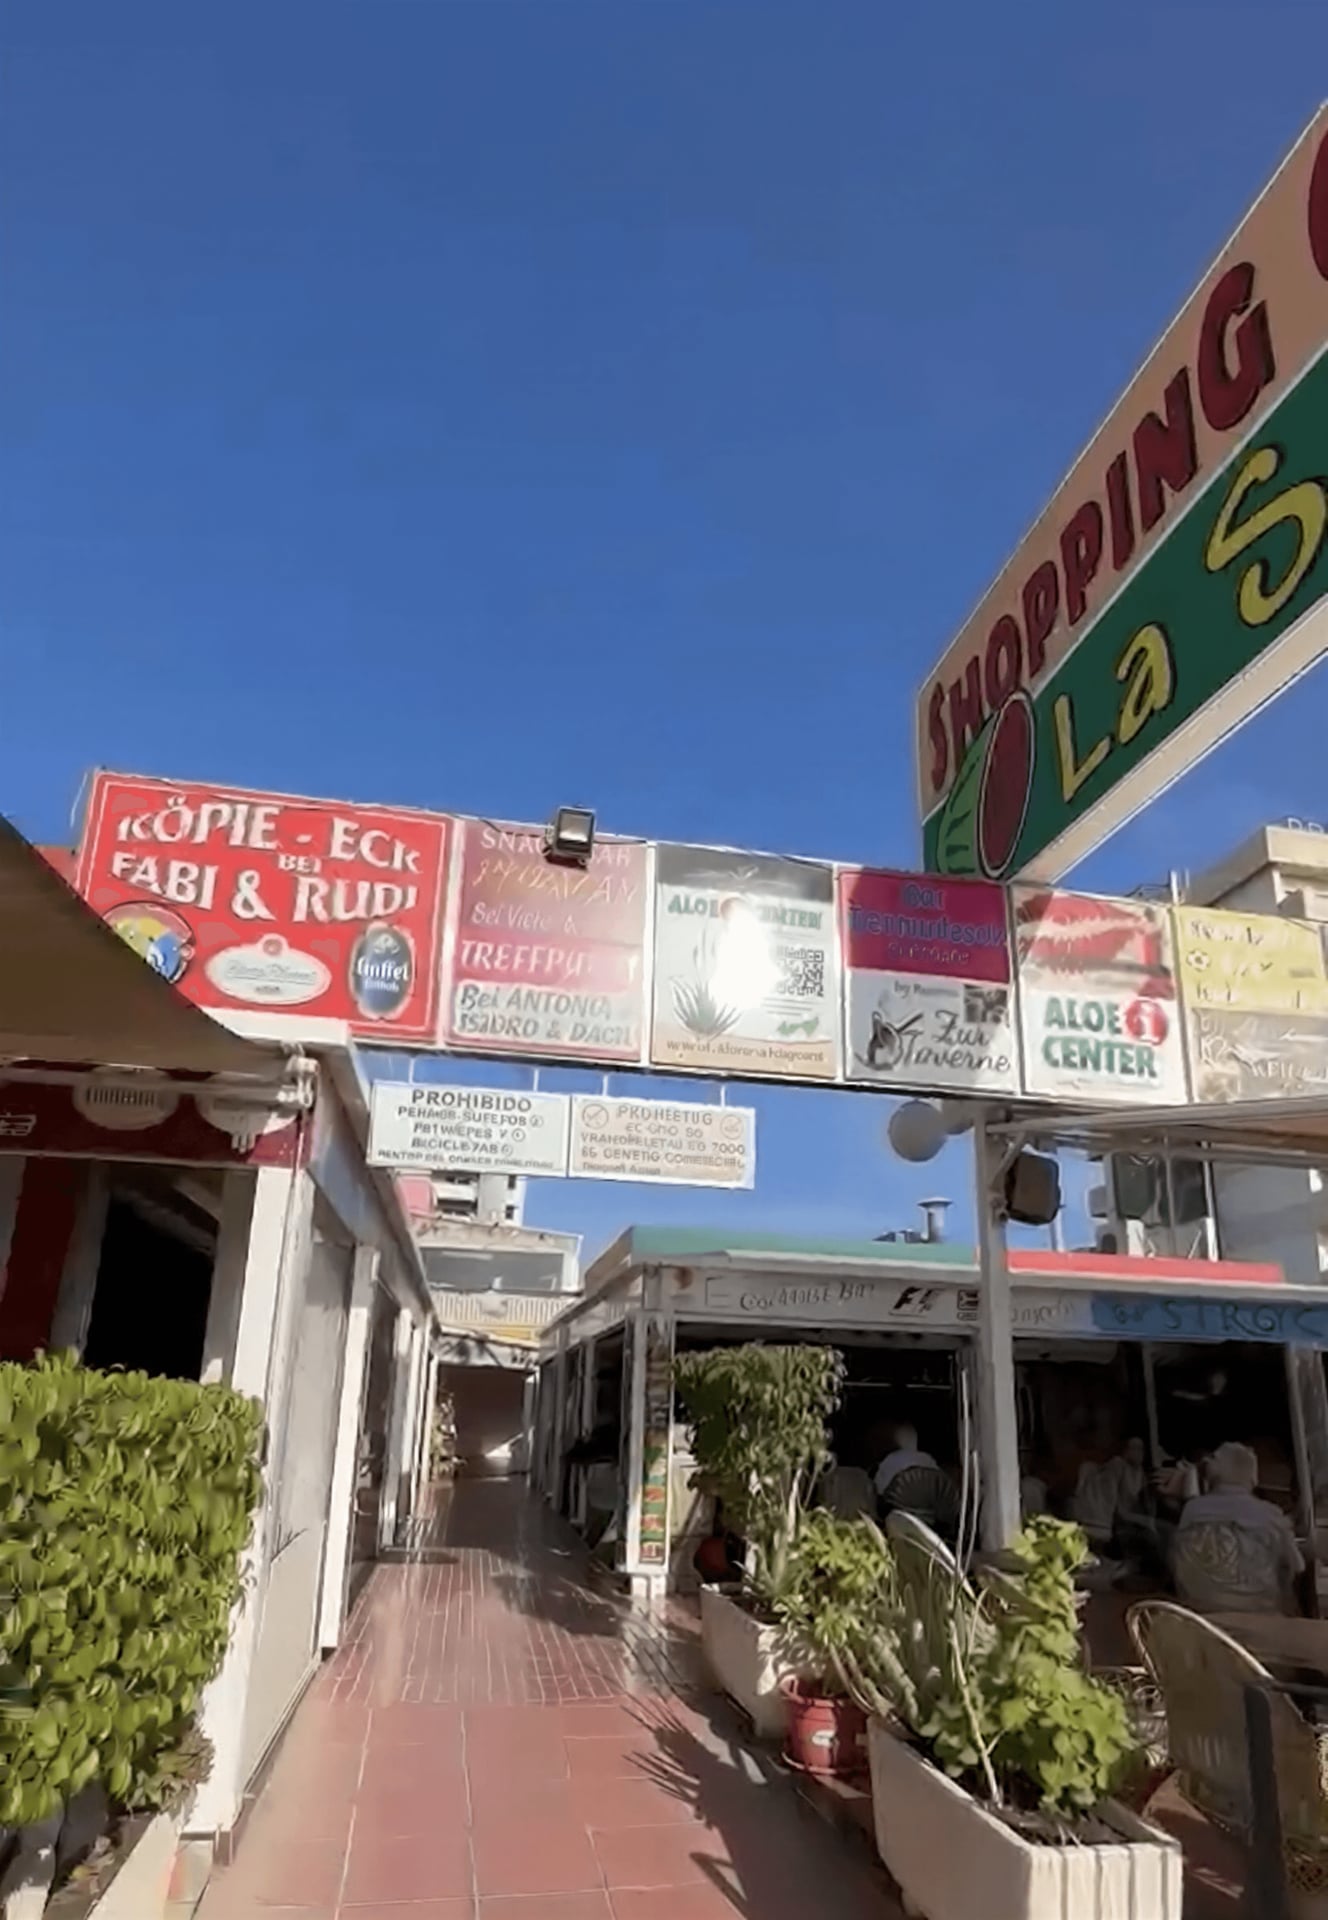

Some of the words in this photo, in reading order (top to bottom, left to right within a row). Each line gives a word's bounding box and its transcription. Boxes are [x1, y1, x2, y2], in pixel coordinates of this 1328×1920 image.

[925, 260, 1277, 793] SHOPPING
[1053, 620, 1177, 804] La
[328, 817, 422, 874] ECK
[110, 851, 219, 911] FABI
[231, 869, 277, 922] &
[293, 875, 418, 923] RUDI
[1043, 996, 1125, 1036] ALOE
[1042, 1036, 1158, 1079] CENTER
[411, 1089, 533, 1113] PROHIBIDO
